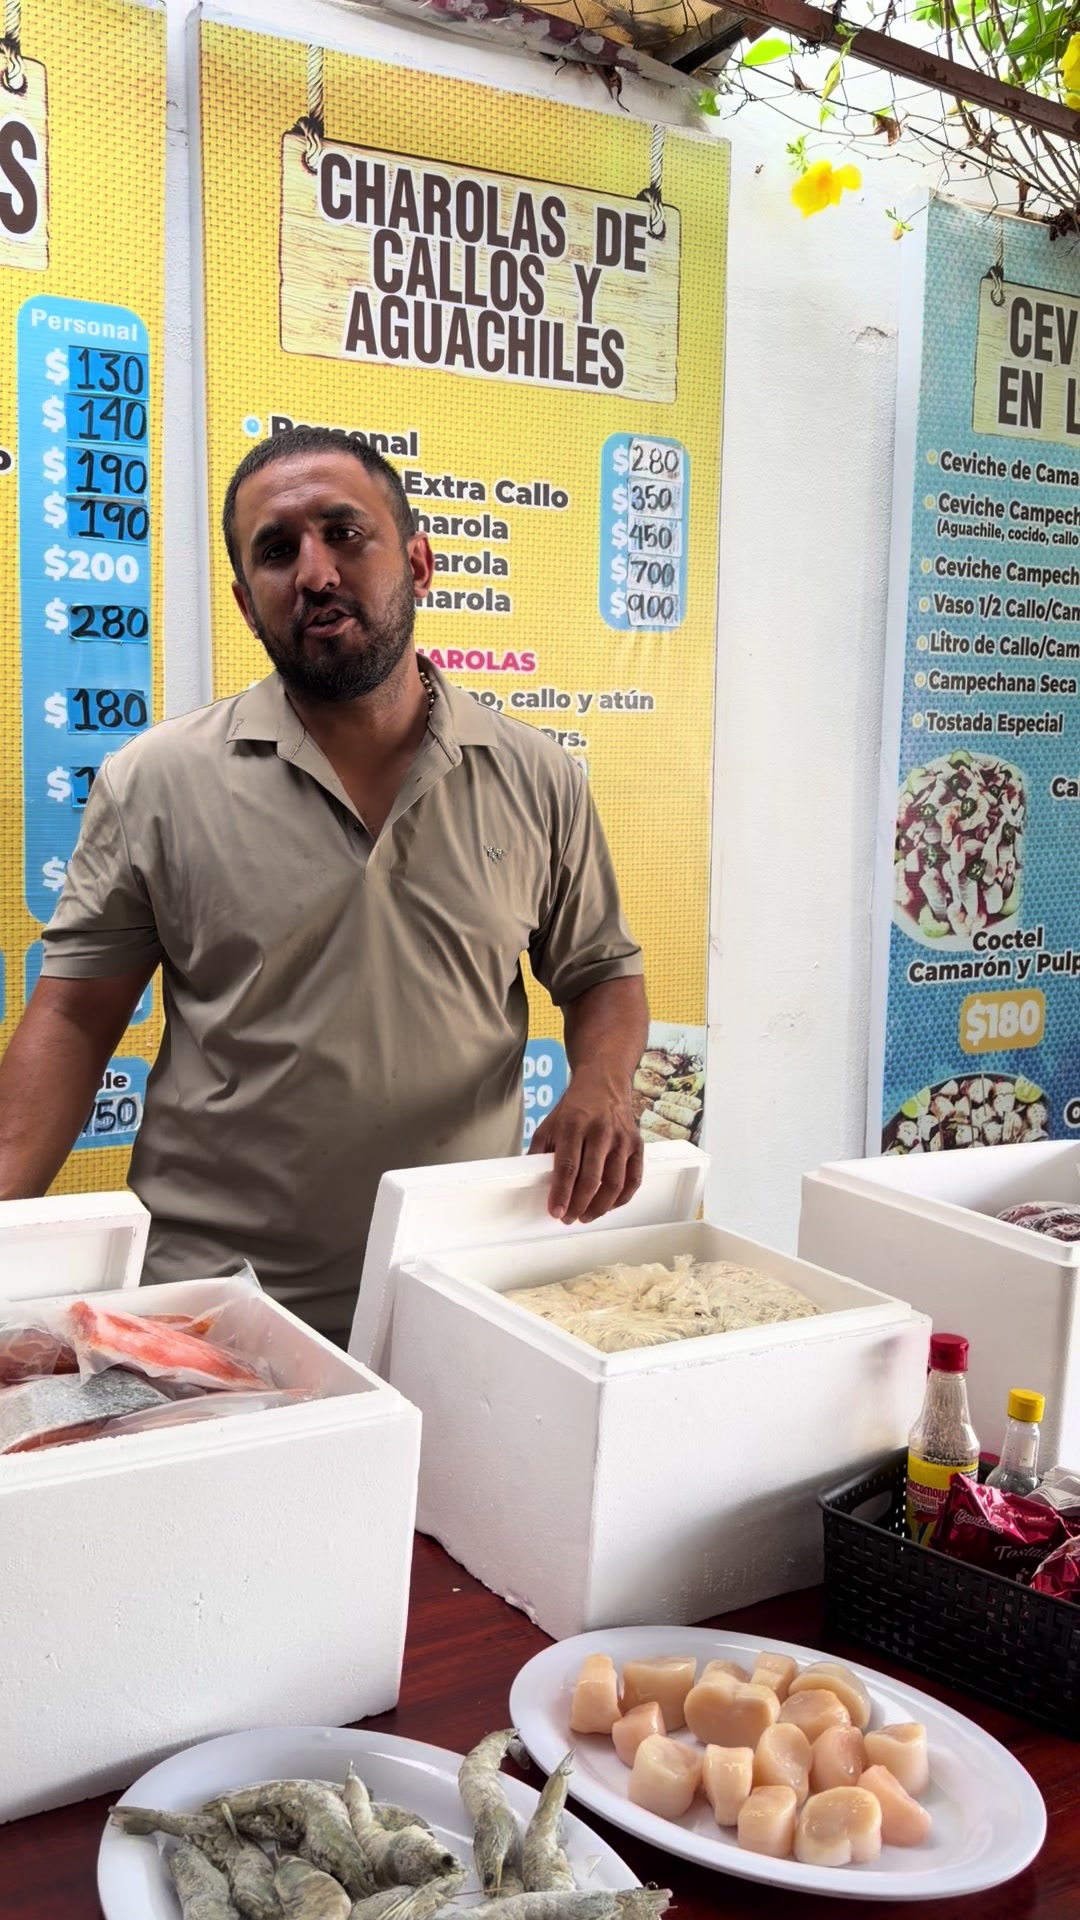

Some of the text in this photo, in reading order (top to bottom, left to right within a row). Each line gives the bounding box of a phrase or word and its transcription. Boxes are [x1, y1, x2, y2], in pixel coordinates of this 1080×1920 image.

[320, 153, 647, 272] CHAROLAS DE
[373, 229, 602, 324] CALLOS Y
[31, 309, 138, 341] Personal
[344, 291, 625, 389] AGUACHILES
[1010, 297, 1078, 365] CEV
[998, 366, 1043, 429] EN
[271, 415, 417, 456] Ponal
[940, 451, 1079, 486] Ceviche de Cama
[404, 471, 569, 508] Extra Callo
[938, 493, 1005, 519] Ceviche
[937, 518, 1079, 546] (Aguachile, cocido, callo
[44, 545, 139, 584] $200
[935, 556, 1080, 588] Ceviche Campech
[934, 594, 974, 615] Vaso
[979, 594, 1001, 619] 1/2
[930, 631, 970, 654] Litro
[974, 634, 995, 654] de
[418, 649, 536, 671] AROLAS
[928, 671, 1077, 695] Campechana Seca
[511, 688, 571, 708] callo
[576, 692, 593, 713] y
[600, 690, 654, 710] atún
[927, 711, 1063, 736] Tostada Especial
[973, 927, 1043, 950] Coctel
[909, 957, 1011, 983] Camarón
[1017, 958, 1031, 980] y
[965, 1000, 1041, 1047] $180
[101, 1071, 128, 1090] le
